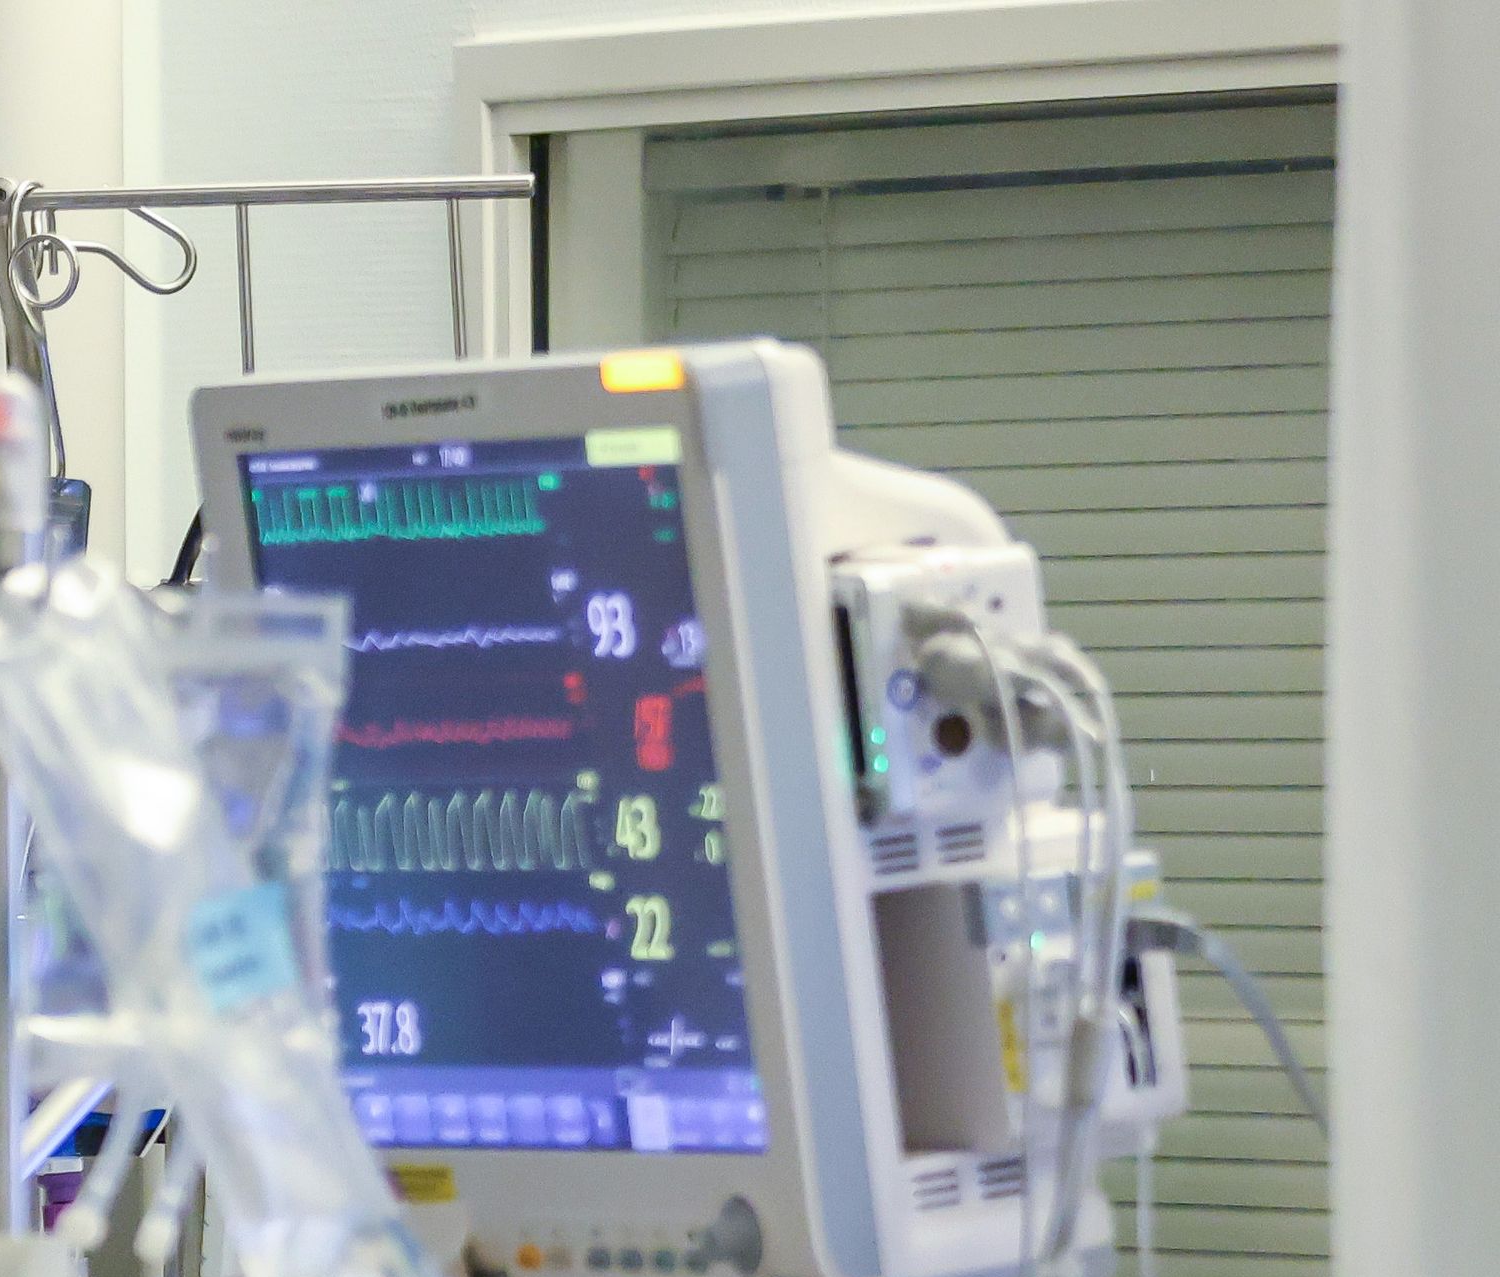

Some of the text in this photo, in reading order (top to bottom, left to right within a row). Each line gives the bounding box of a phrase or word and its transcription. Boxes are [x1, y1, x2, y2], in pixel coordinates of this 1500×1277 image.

[587, 594, 635, 658] 93
[616, 796, 661, 860] 43
[625, 895, 674, 961] 22
